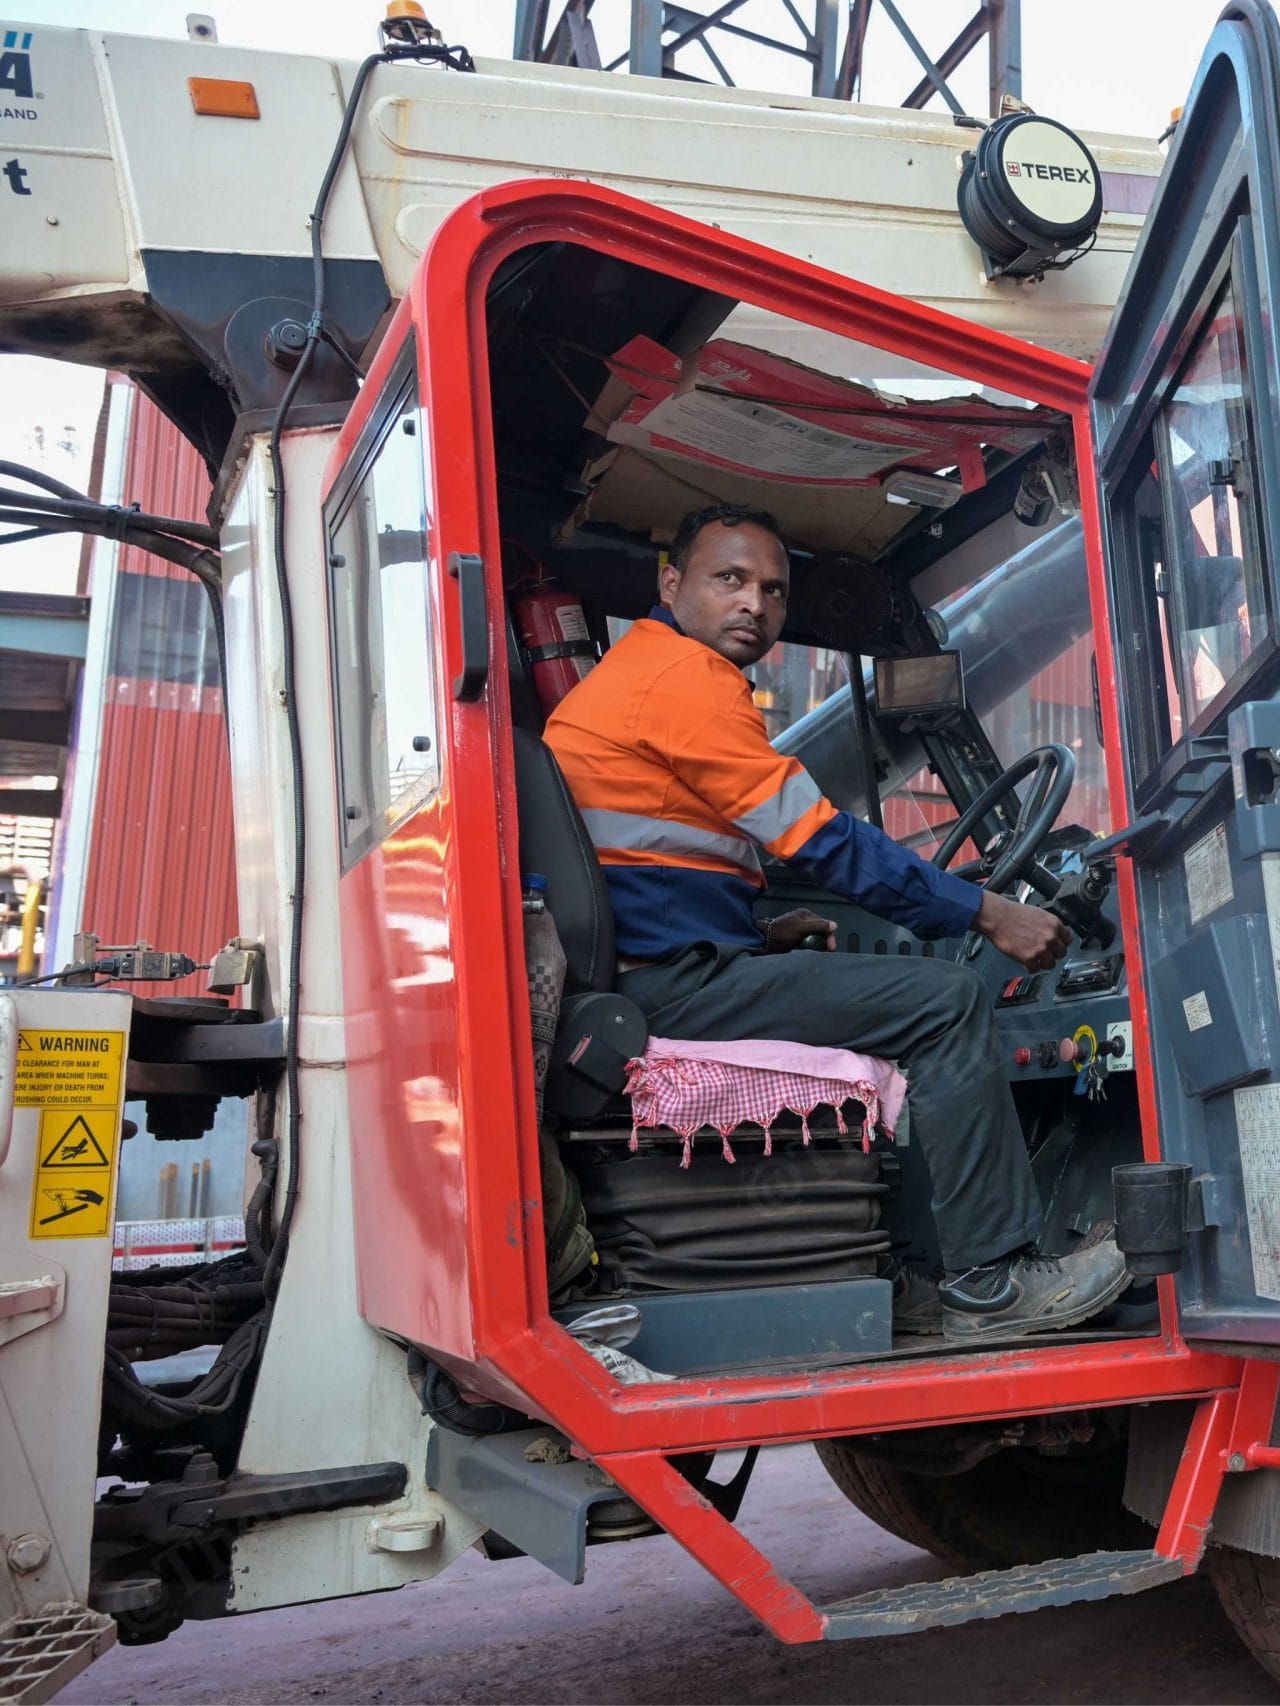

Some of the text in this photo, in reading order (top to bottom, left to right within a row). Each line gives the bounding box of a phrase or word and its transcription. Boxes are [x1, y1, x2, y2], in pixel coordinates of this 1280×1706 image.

[0, 107, 38, 121] AND
[1021, 162, 1092, 185] TEREX
[39, 1036, 110, 1053] WARNING
[61, 1060, 75, 1068] FOR
[76, 1060, 91, 1068] MAN
[91, 1060, 100, 1068] AT
[35, 1071, 55, 1080] WHEN
[55, 1072, 85, 1080] MACHINE
[29, 1083, 53, 1092] INJURY
[54, 1083, 63, 1092] OR
[64, 1083, 85, 1092] DEATH
[86, 1083, 105, 1092] FROM
[46, 1095, 69, 1104] COULD
